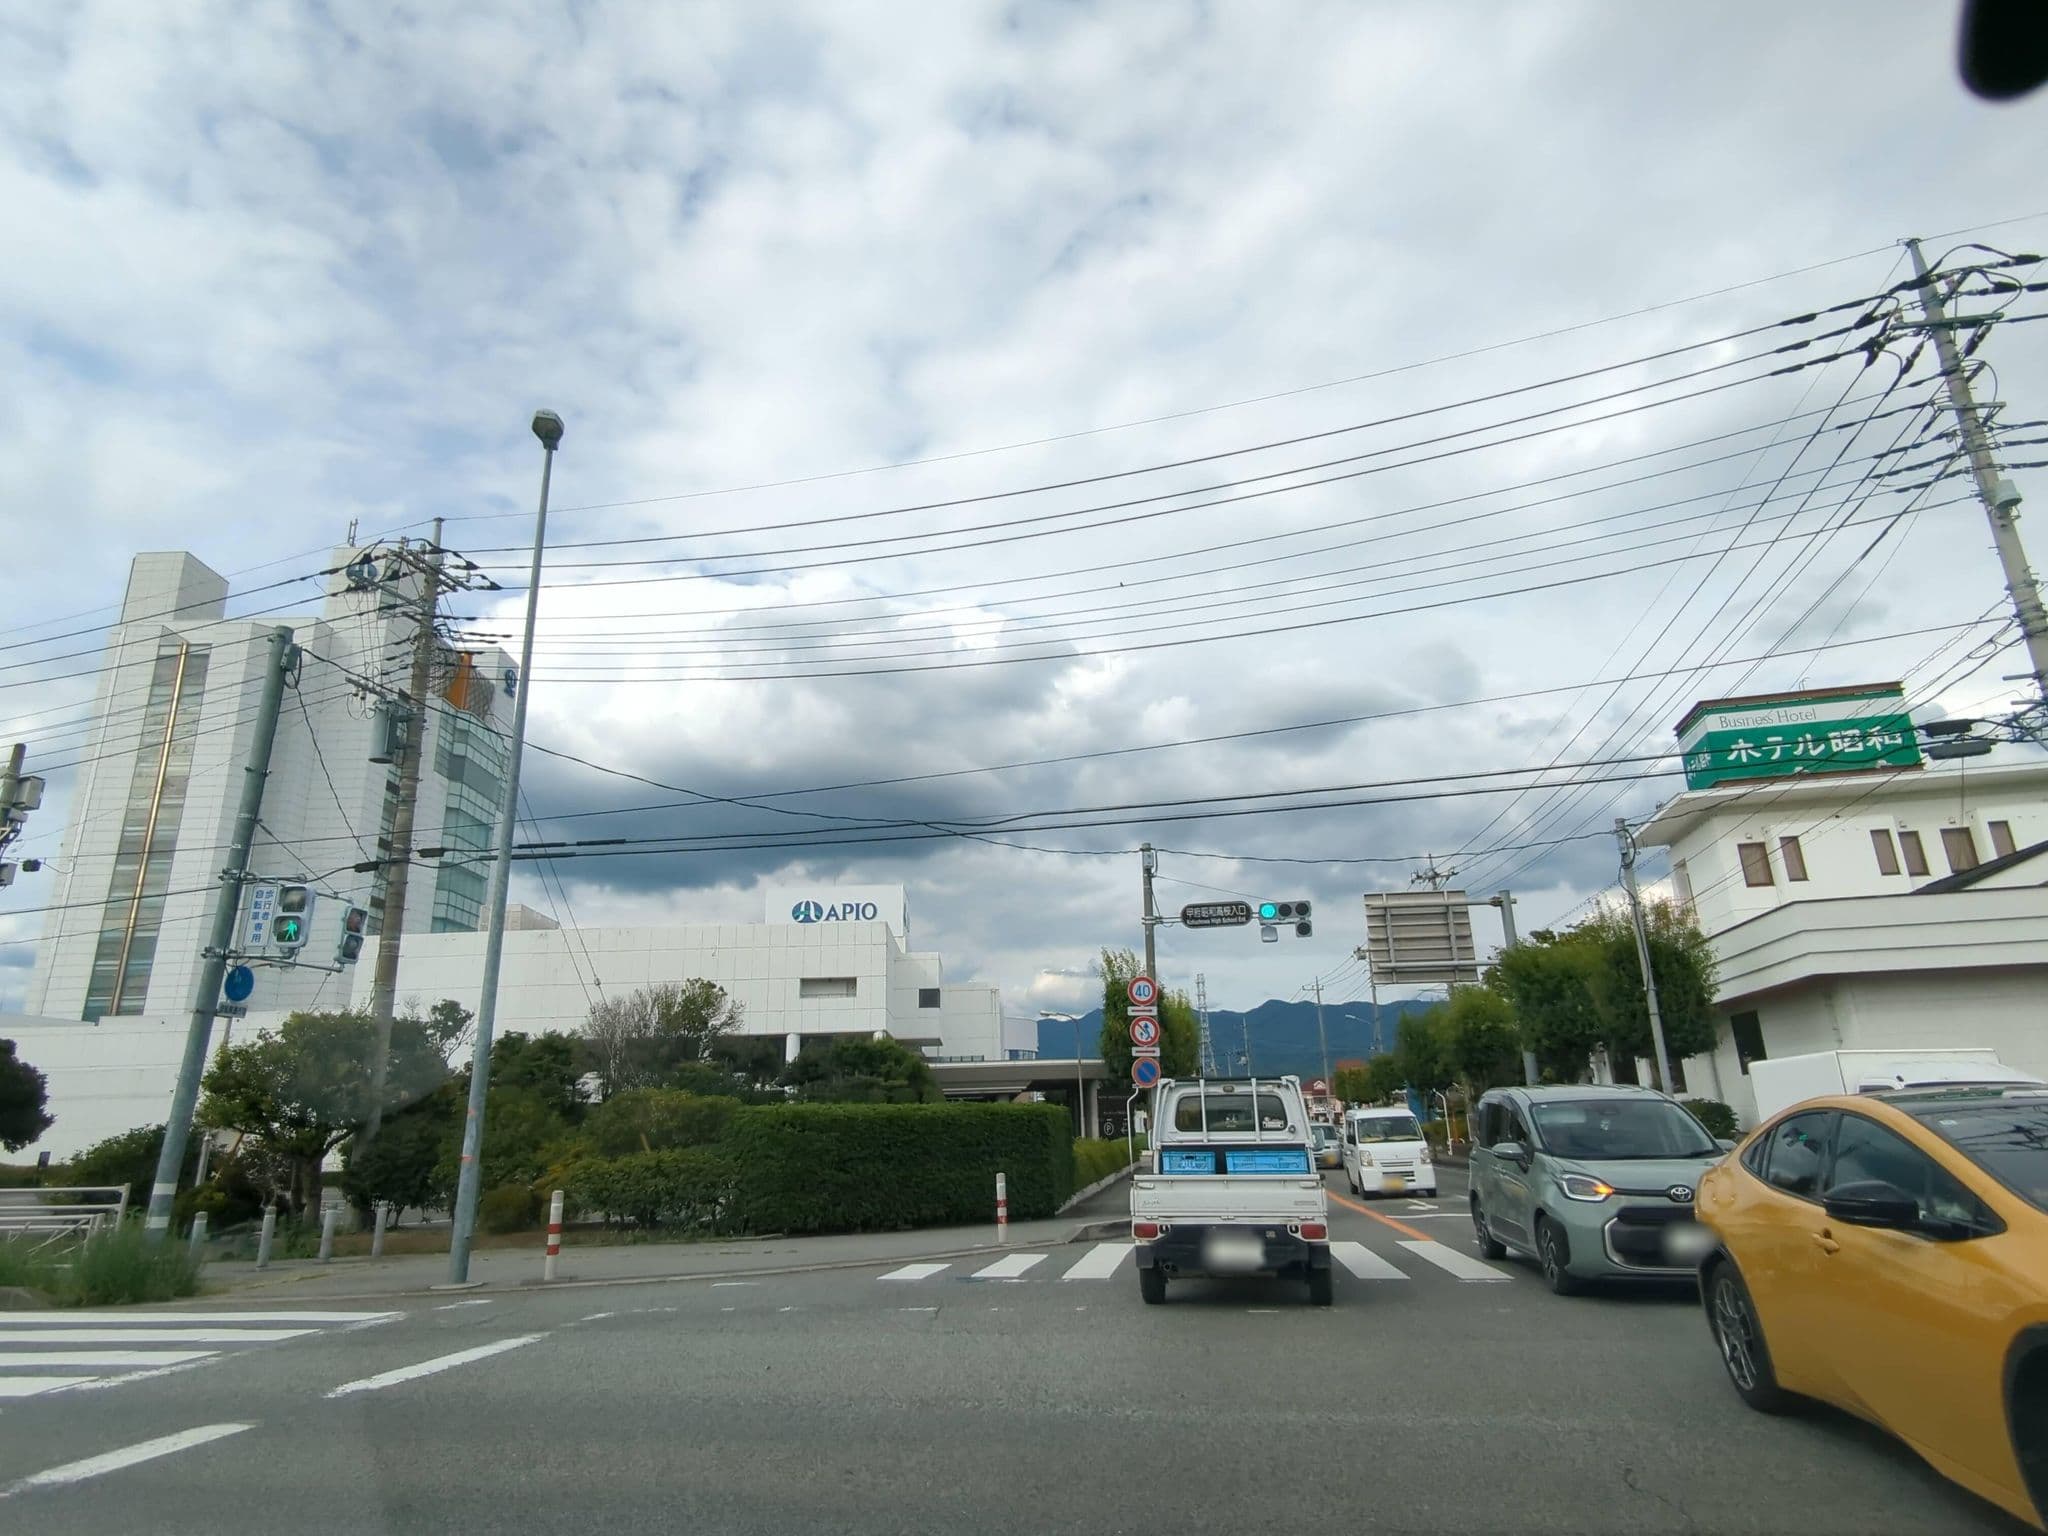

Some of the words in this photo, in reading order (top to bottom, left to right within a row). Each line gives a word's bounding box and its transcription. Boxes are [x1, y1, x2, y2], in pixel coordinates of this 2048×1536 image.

[1719, 713, 1774, 728] Business
[1776, 707, 1817, 723] Hotel
[1727, 726, 1902, 763] ホテル昭和
[824, 903, 876, 921] APIO
[1135, 985, 1151, 997] 40
